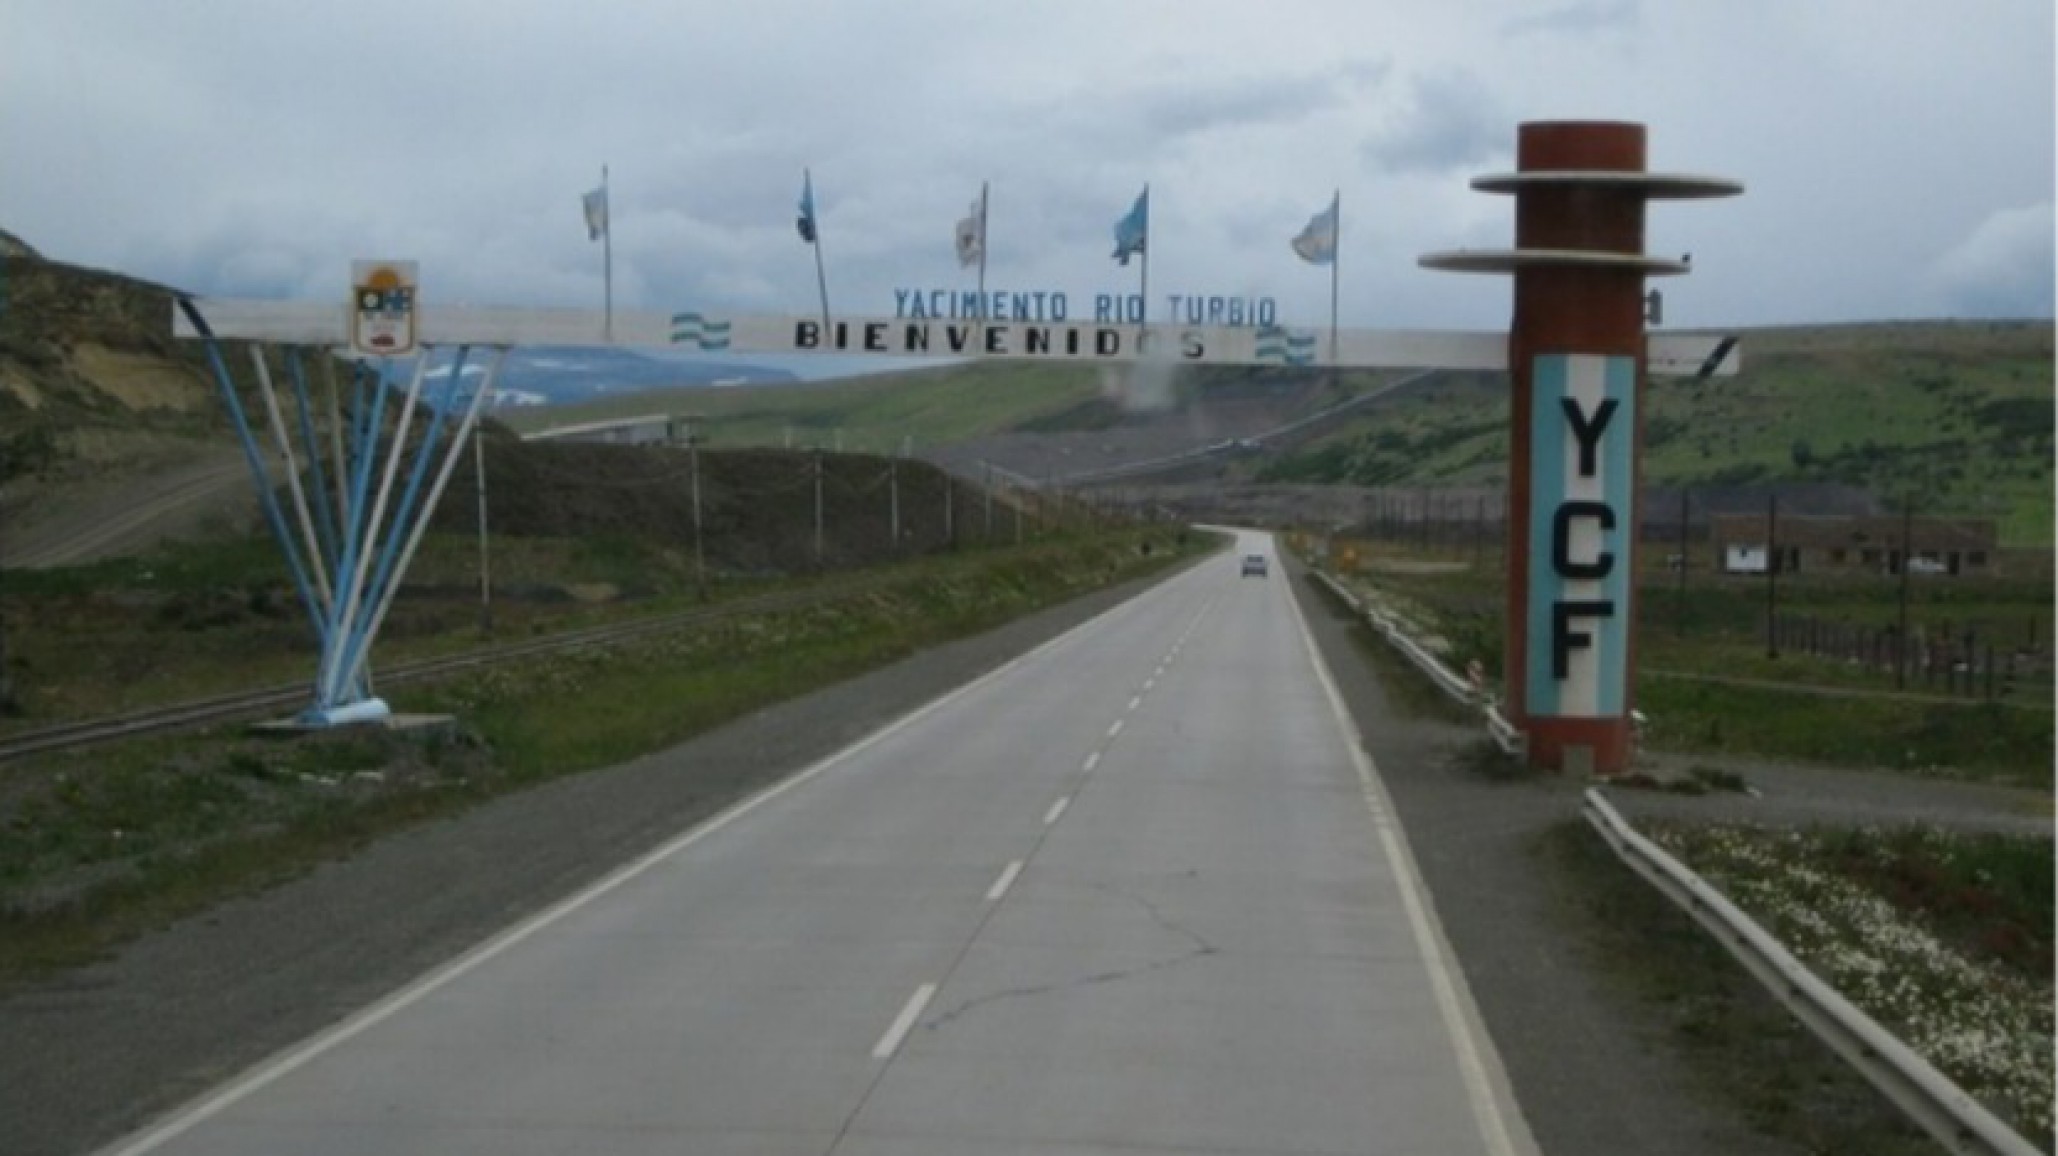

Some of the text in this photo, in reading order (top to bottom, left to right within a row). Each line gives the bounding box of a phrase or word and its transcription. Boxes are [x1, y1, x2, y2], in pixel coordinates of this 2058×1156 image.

[894, 287, 1275, 327] YACIMIENTO RIO TURBIO
[1552, 396, 1620, 681] YCF
